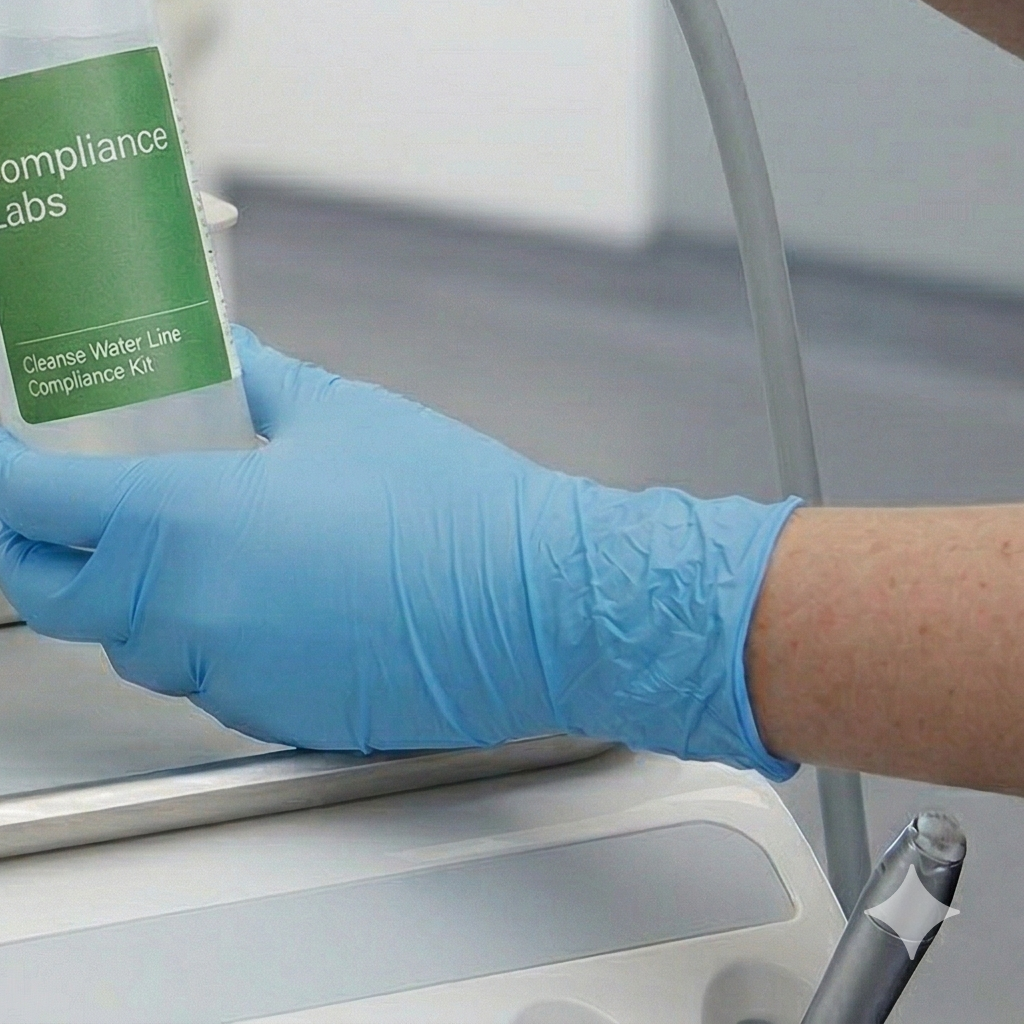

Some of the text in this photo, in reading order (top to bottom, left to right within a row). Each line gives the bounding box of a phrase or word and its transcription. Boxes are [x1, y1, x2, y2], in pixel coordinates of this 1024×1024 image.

[22, 327, 182, 374] Cleanse Water Line
[28, 355, 154, 397] Compliance Kit
